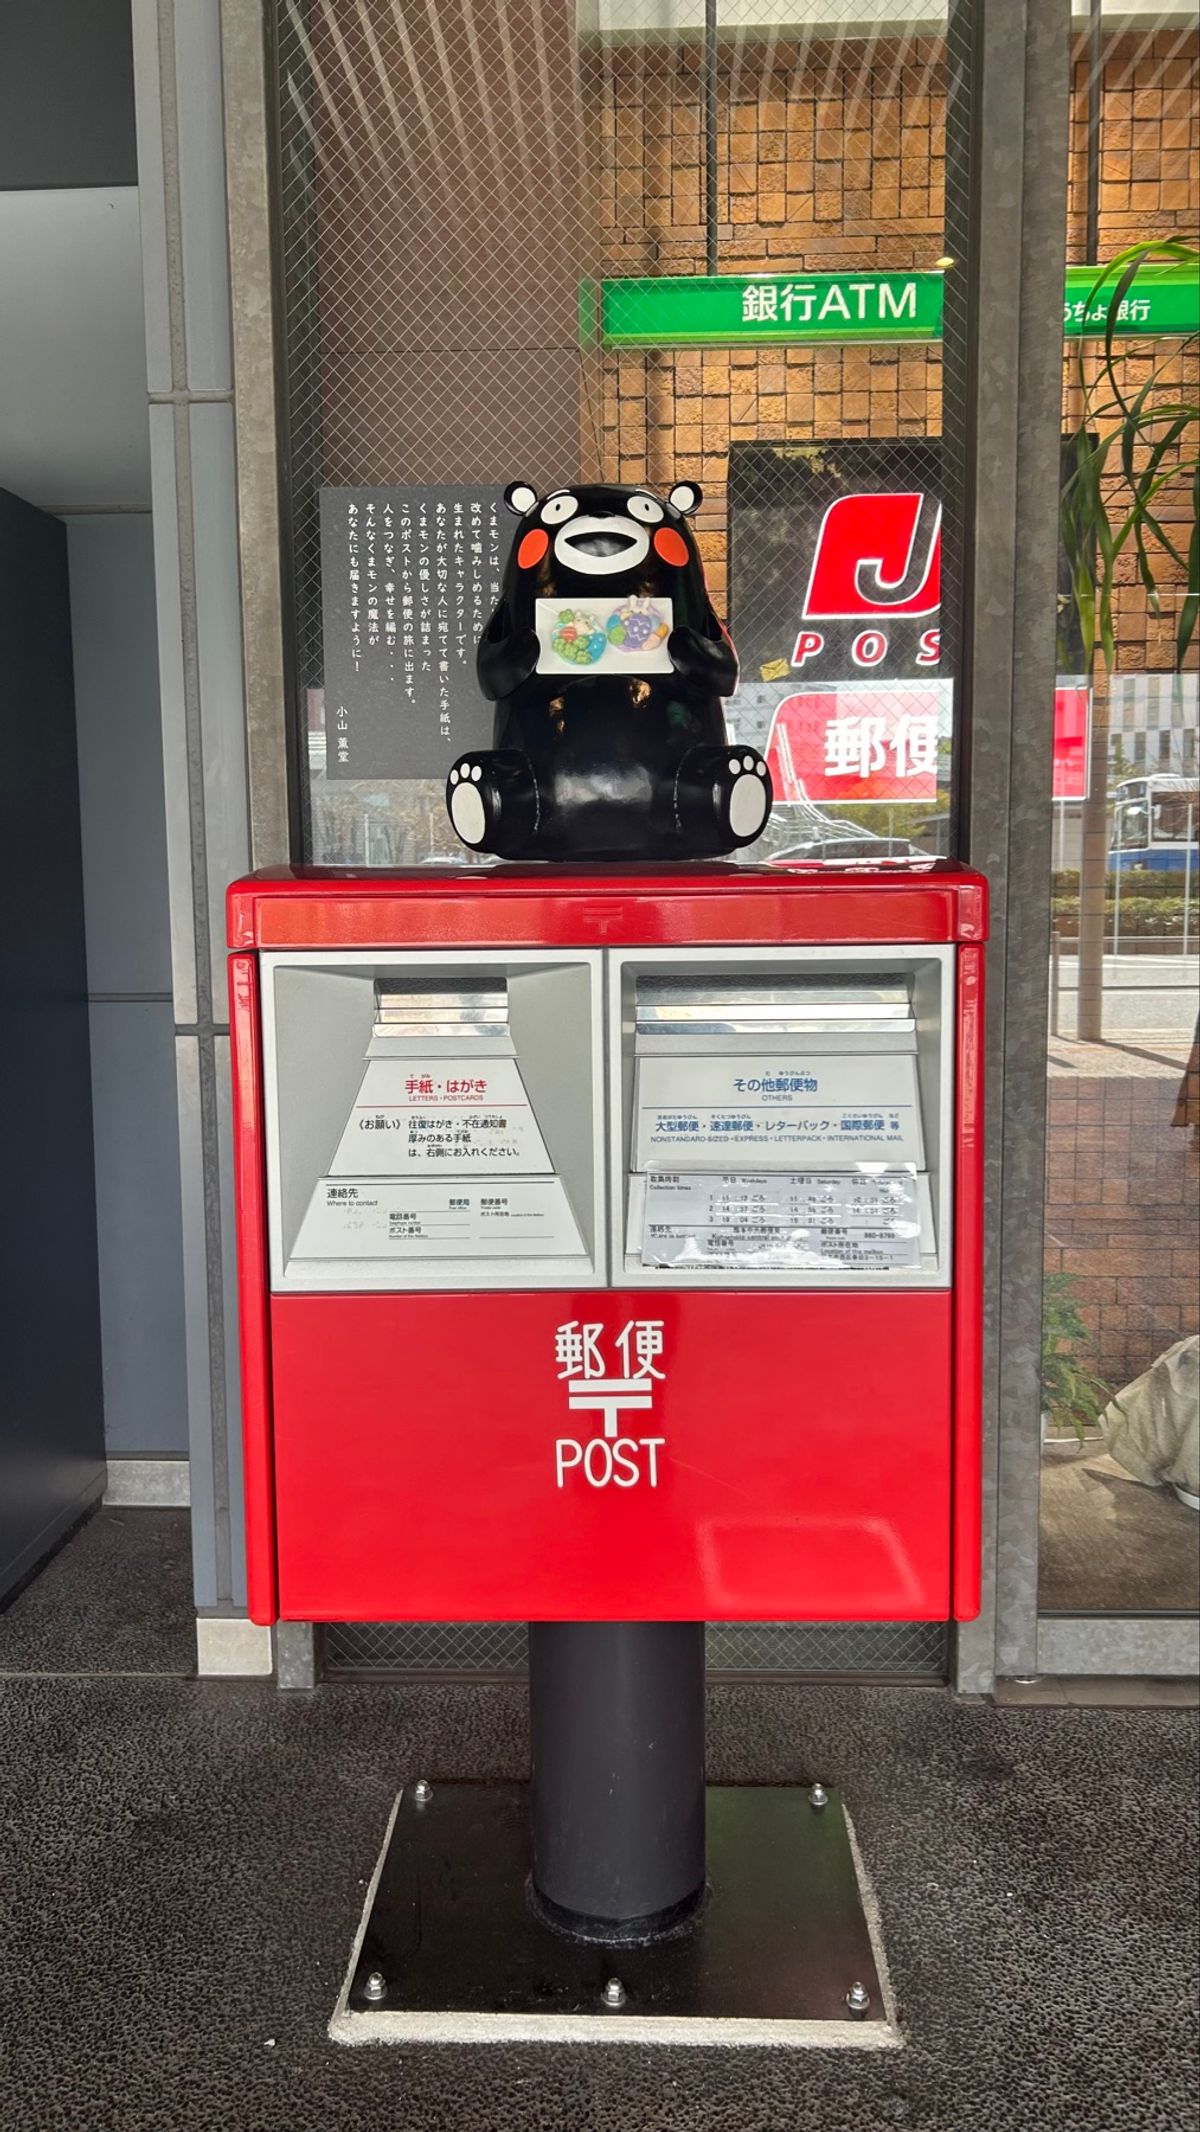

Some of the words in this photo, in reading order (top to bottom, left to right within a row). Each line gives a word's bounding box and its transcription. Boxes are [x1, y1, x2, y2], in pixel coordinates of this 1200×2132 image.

[741, 283, 917, 322] 銀行ATM
[366, 503, 380, 645] そんなくまモンの魔法が
[453, 502, 467, 665] 生まれたキャラクターです。
[489, 502, 500, 612] くまモンは、当た
[401, 504, 416, 704] このポストから郵便の旅に出ます。
[419, 503, 432, 671] くまモンの優しさが詰まった
[436, 503, 451, 742] あなたが大切な人に宛てて書いた手紙は、
[823, 714, 939, 779] 郵便
[405, 1080, 487, 1094] 手紙・はがき
[733, 1078, 818, 1092] その他郵便物
[408, 1134, 471, 1143] 厚みのある手紙
[408, 1148, 520, 1157] は、右側にお入れください。
[327, 1188, 359, 1199] 連絡先
[555, 1320, 666, 1379] 郵便
[556, 1438, 665, 1488] POST
